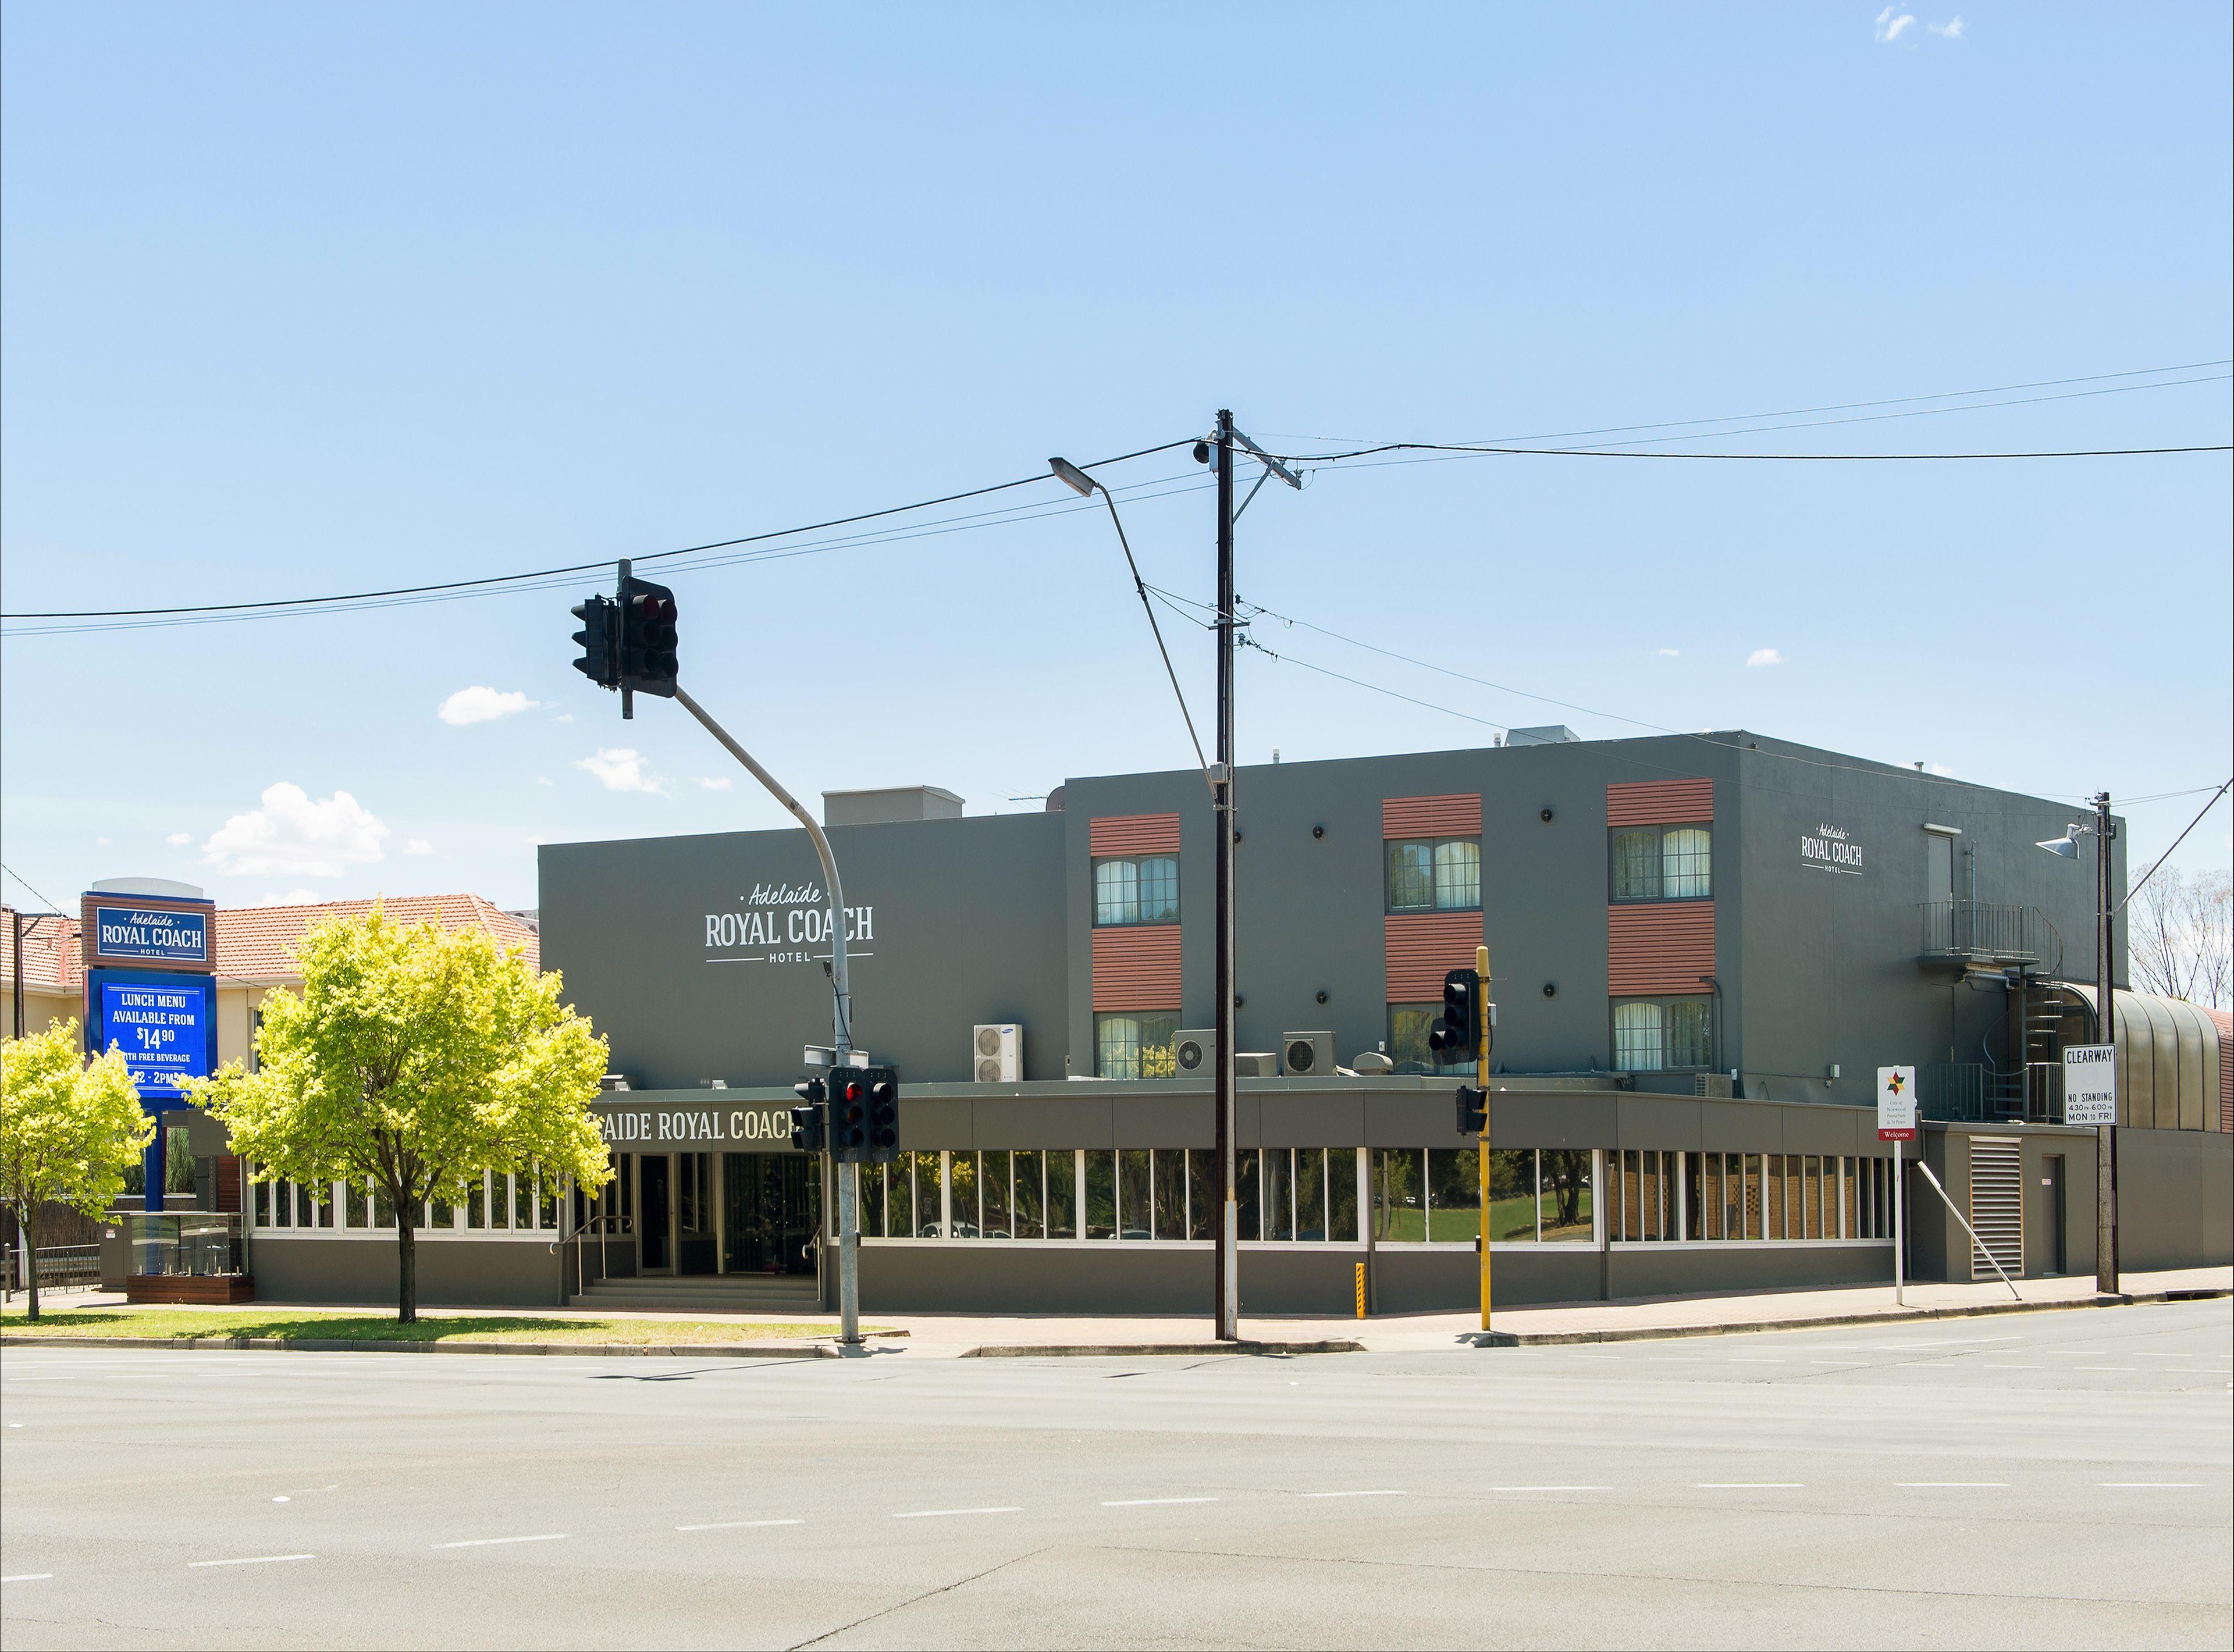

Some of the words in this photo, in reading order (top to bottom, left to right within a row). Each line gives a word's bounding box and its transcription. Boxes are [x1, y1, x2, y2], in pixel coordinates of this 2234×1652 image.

[1819, 822, 1846, 840] Adelaide
[1801, 836, 1831, 861] ROYAL
[1833, 842, 1862, 866] COACH
[1824, 865, 1841, 874] HOTEL
[749, 881, 823, 906] Adelaide
[130, 912, 174, 927] Adelaide
[705, 911, 781, 947] ROYAL
[788, 906, 874, 943] COACH
[102, 925, 150, 945] ROYAL
[152, 928, 202, 948] COACH
[769, 952, 811, 963] HOTEL
[121, 993, 155, 1007] LUNCH
[157, 995, 186, 1008] MENU
[112, 1010, 166, 1024] AVAILABLE
[169, 1013, 195, 1026] FROM
[138, 1053, 155, 1062] FREE
[156, 1053, 190, 1062] BEVERAGE
[2066, 1049, 2113, 1064] CLEARWAY
[2068, 1094, 2077, 1103] NO
[2082, 1092, 2112, 1102] STANDING
[2068, 1113, 2088, 1121] MON
[2098, 1112, 2112, 1120] FRI
[592, 1112, 652, 1141] AIDE
[658, 1112, 725, 1141] ROYAL
